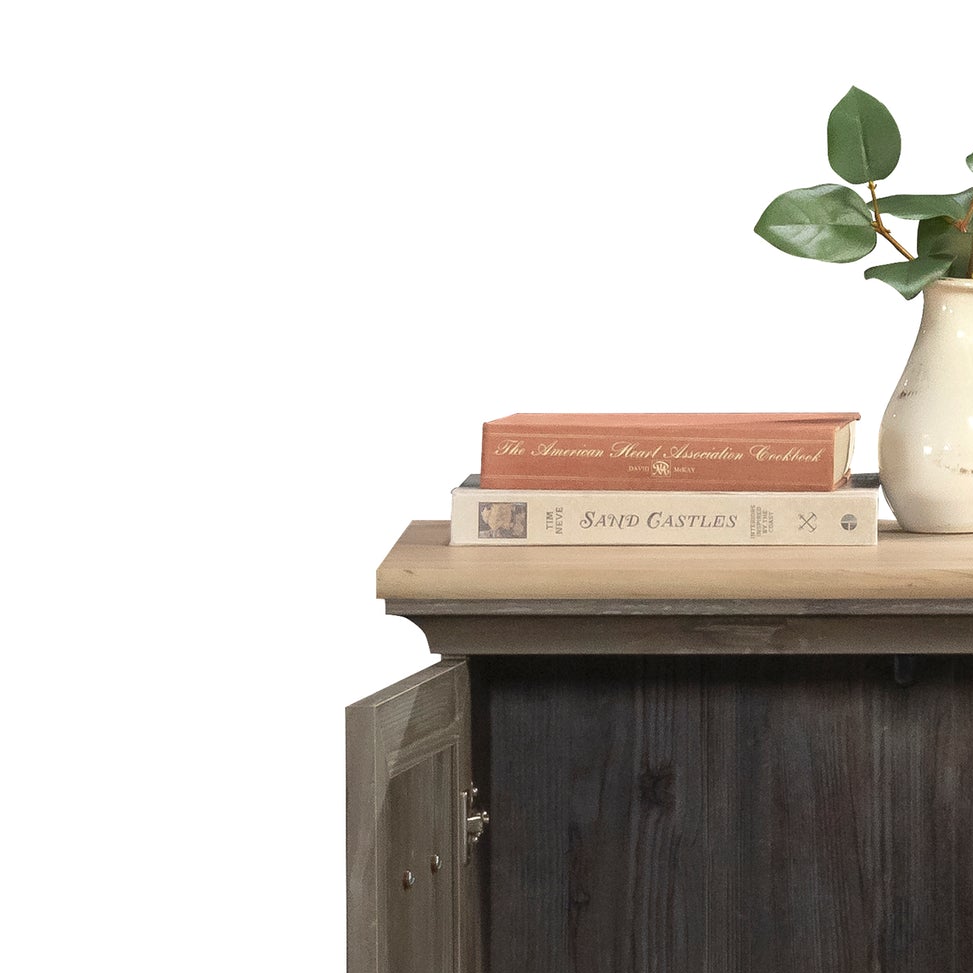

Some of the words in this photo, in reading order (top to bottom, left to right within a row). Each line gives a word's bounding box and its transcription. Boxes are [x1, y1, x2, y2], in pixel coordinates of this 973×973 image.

[494, 439, 525, 456] The
[531, 440, 604, 457] American
[609, 441, 662, 458] Heart
[662, 443, 744, 460] Association
[749, 444, 826, 463] Cookbook
[628, 465, 650, 473] DAVID
[545, 511, 554, 530] TIM
[555, 506, 564, 534] NEVE
[579, 511, 640, 530] SAND
[646, 511, 738, 529] CASTLES
